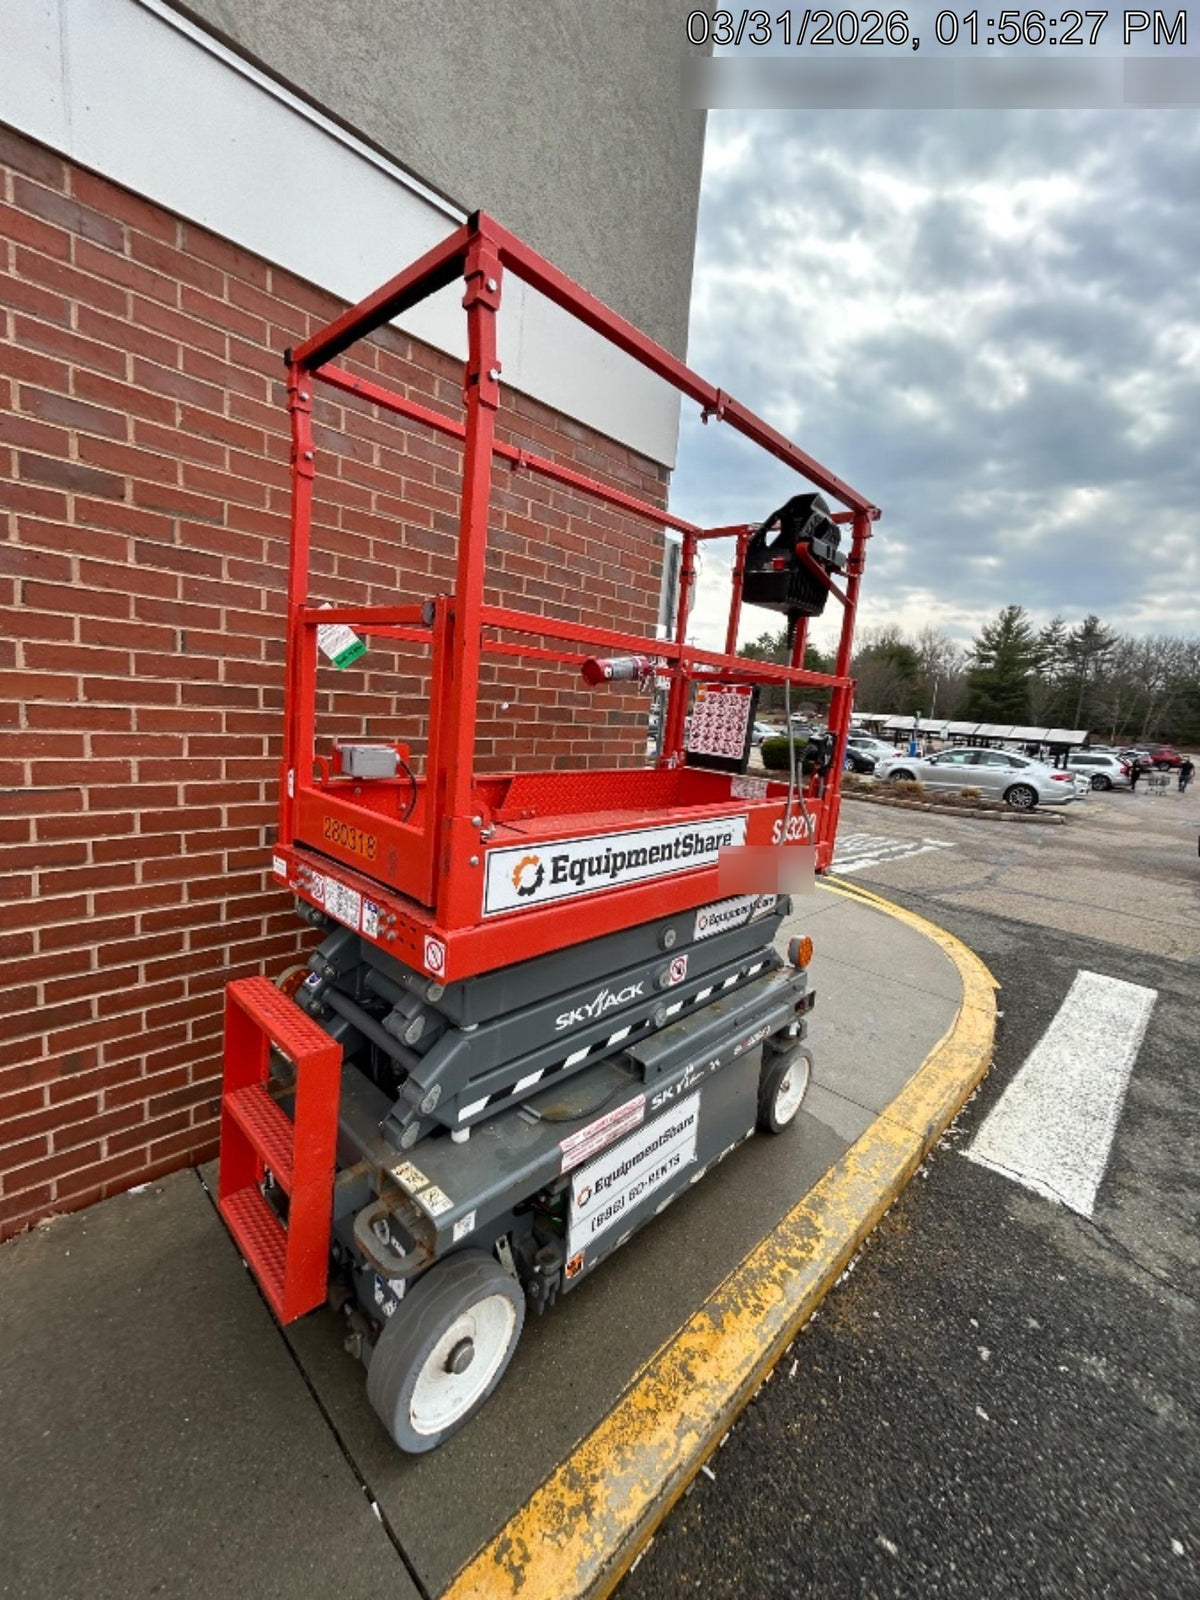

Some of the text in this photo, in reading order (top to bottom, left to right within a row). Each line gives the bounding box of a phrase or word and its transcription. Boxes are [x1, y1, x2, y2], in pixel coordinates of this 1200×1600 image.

[324, 817, 376, 860] 280318
[550, 832, 732, 886] EquipmentShare
[555, 981, 644, 1031] SKYJACK
[593, 1114, 694, 1195] EquipmentShare
